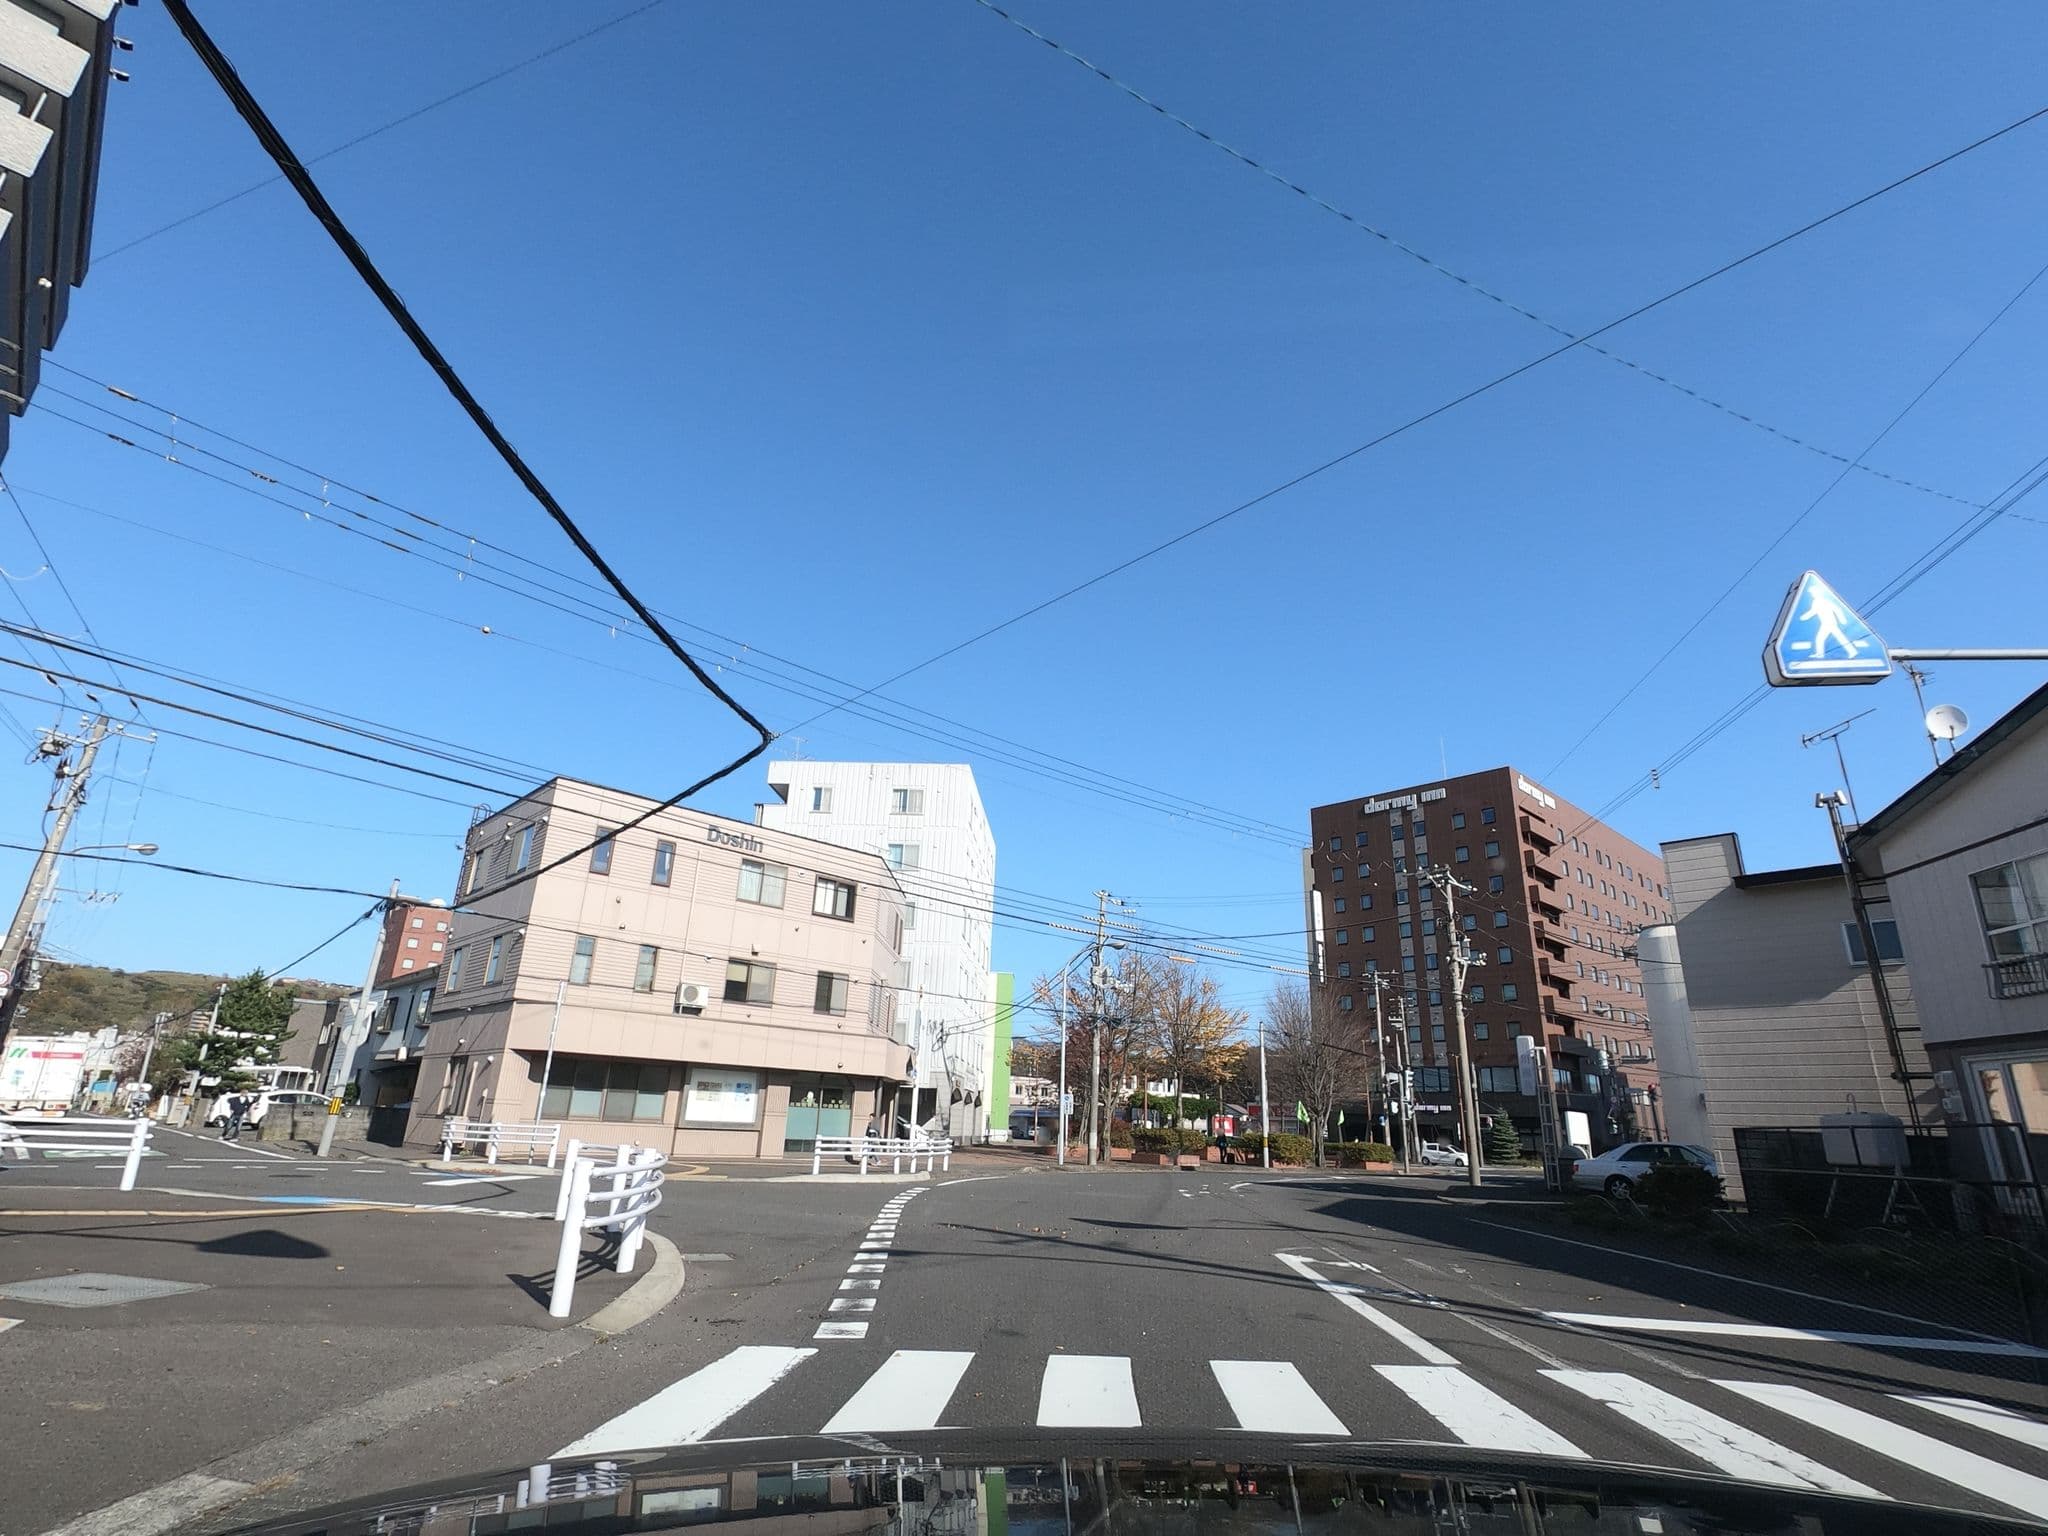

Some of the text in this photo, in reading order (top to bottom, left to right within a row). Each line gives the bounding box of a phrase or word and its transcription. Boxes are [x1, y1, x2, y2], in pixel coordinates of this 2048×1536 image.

[1364, 787, 1447, 815] dormy inn
[707, 825, 763, 853] Doshin
